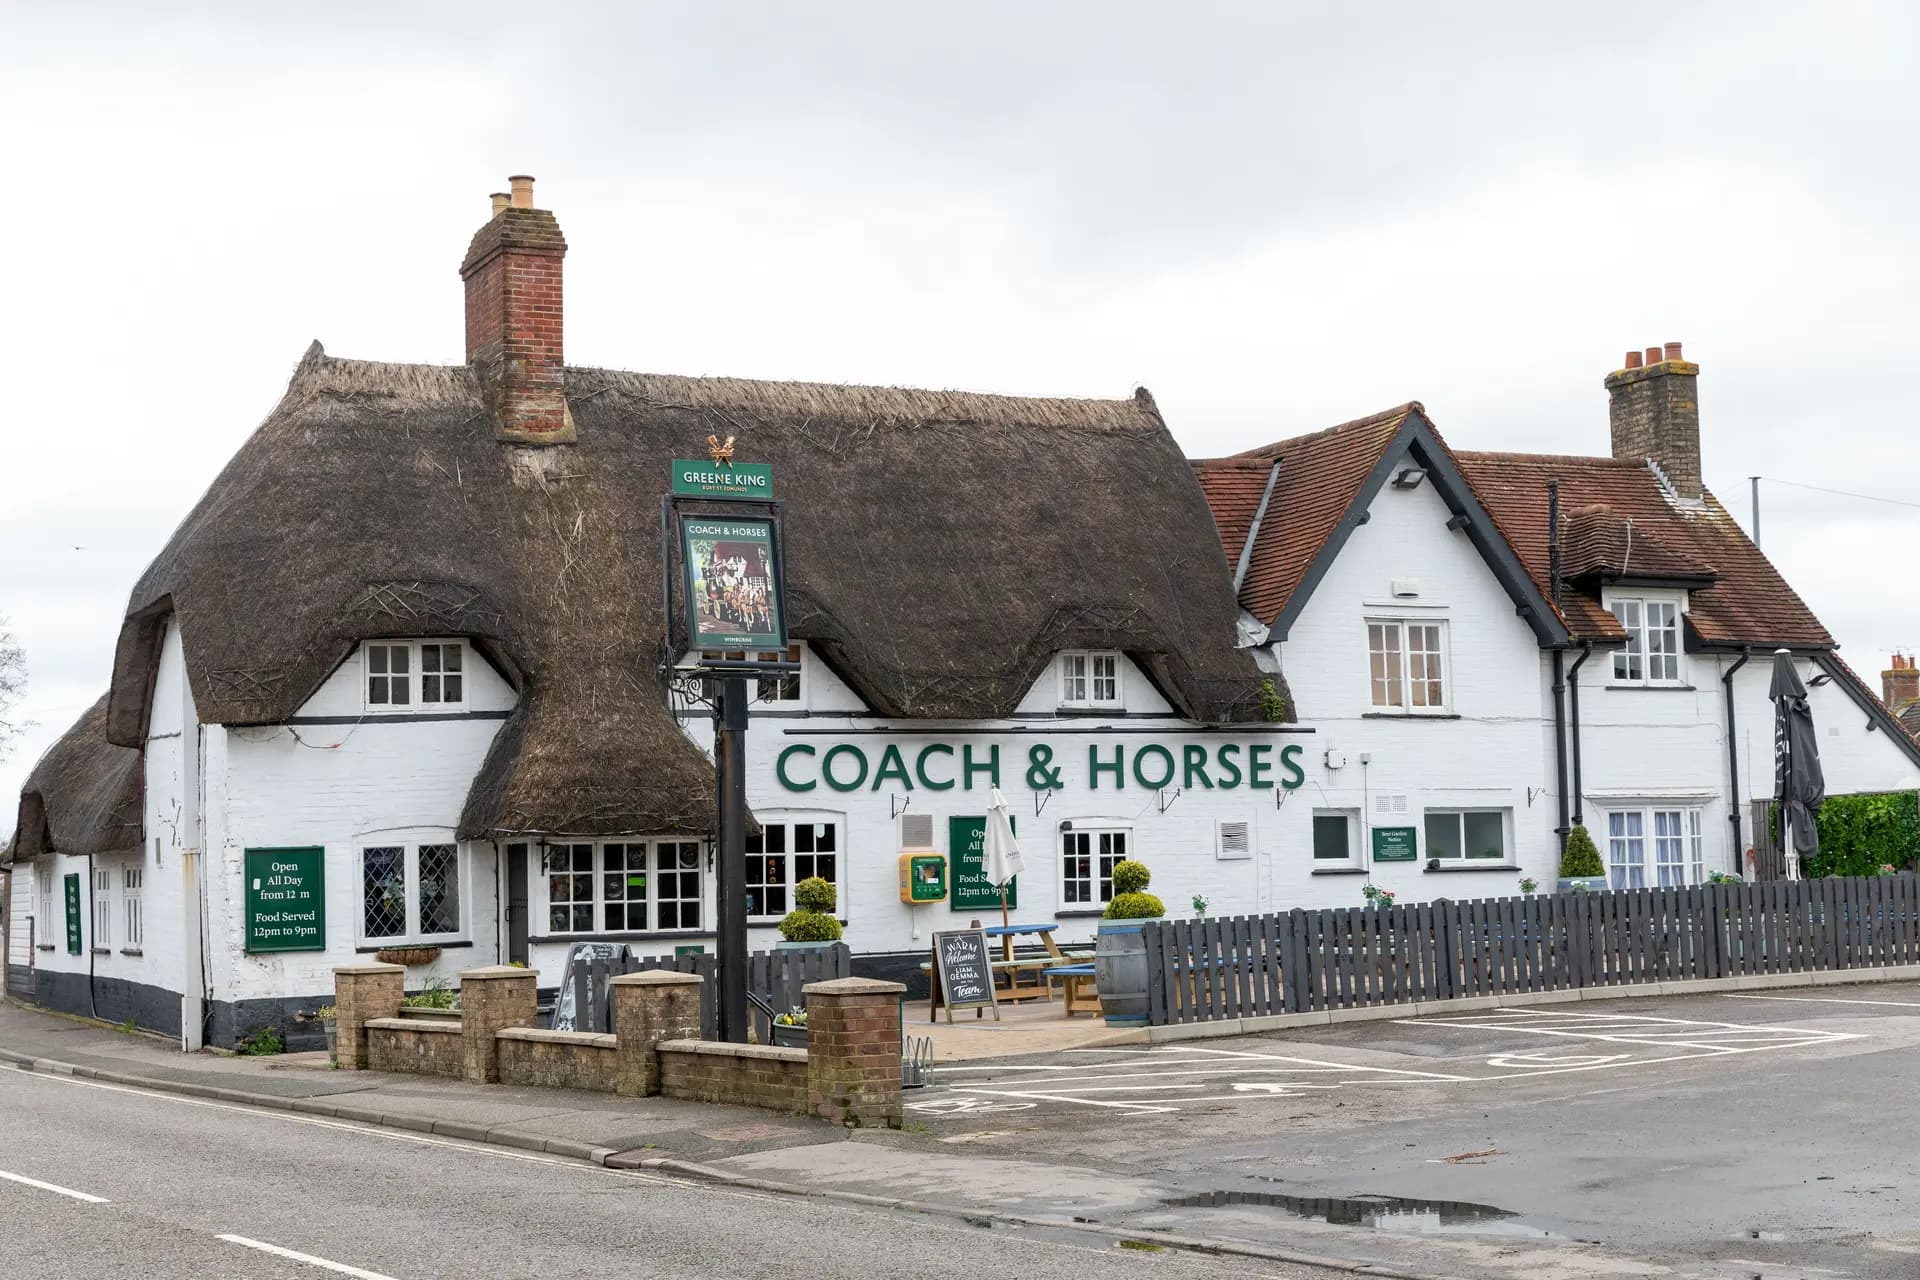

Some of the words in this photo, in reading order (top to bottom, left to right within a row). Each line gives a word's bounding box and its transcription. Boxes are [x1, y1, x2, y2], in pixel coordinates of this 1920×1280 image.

[683, 472, 731, 484] GREENE
[735, 474, 766, 486] KING
[688, 525, 721, 535] COACH
[723, 527, 731, 536] &
[732, 527, 767, 537] HORSES
[776, 743, 1000, 792] COACH
[1026, 744, 1064, 790] &
[1089, 744, 1305, 790] HORSES
[968, 841, 980, 850] All
[963, 853, 982, 863] from
[271, 862, 298, 873] Open
[267, 875, 281, 886] All
[283, 876, 303, 887] Day
[959, 874, 979, 883] Food
[260, 889, 284, 900] from
[958, 887, 980, 898] 12pm
[255, 911, 280, 922] Food
[282, 910, 316, 921] Served
[254, 927, 281, 939] 12pm
[283, 928, 293, 936] to
[294, 926, 317, 936] 9pm
[946, 941, 978, 953] WARM
[945, 950, 977, 966] Welcome
[953, 984, 984, 998] Team
